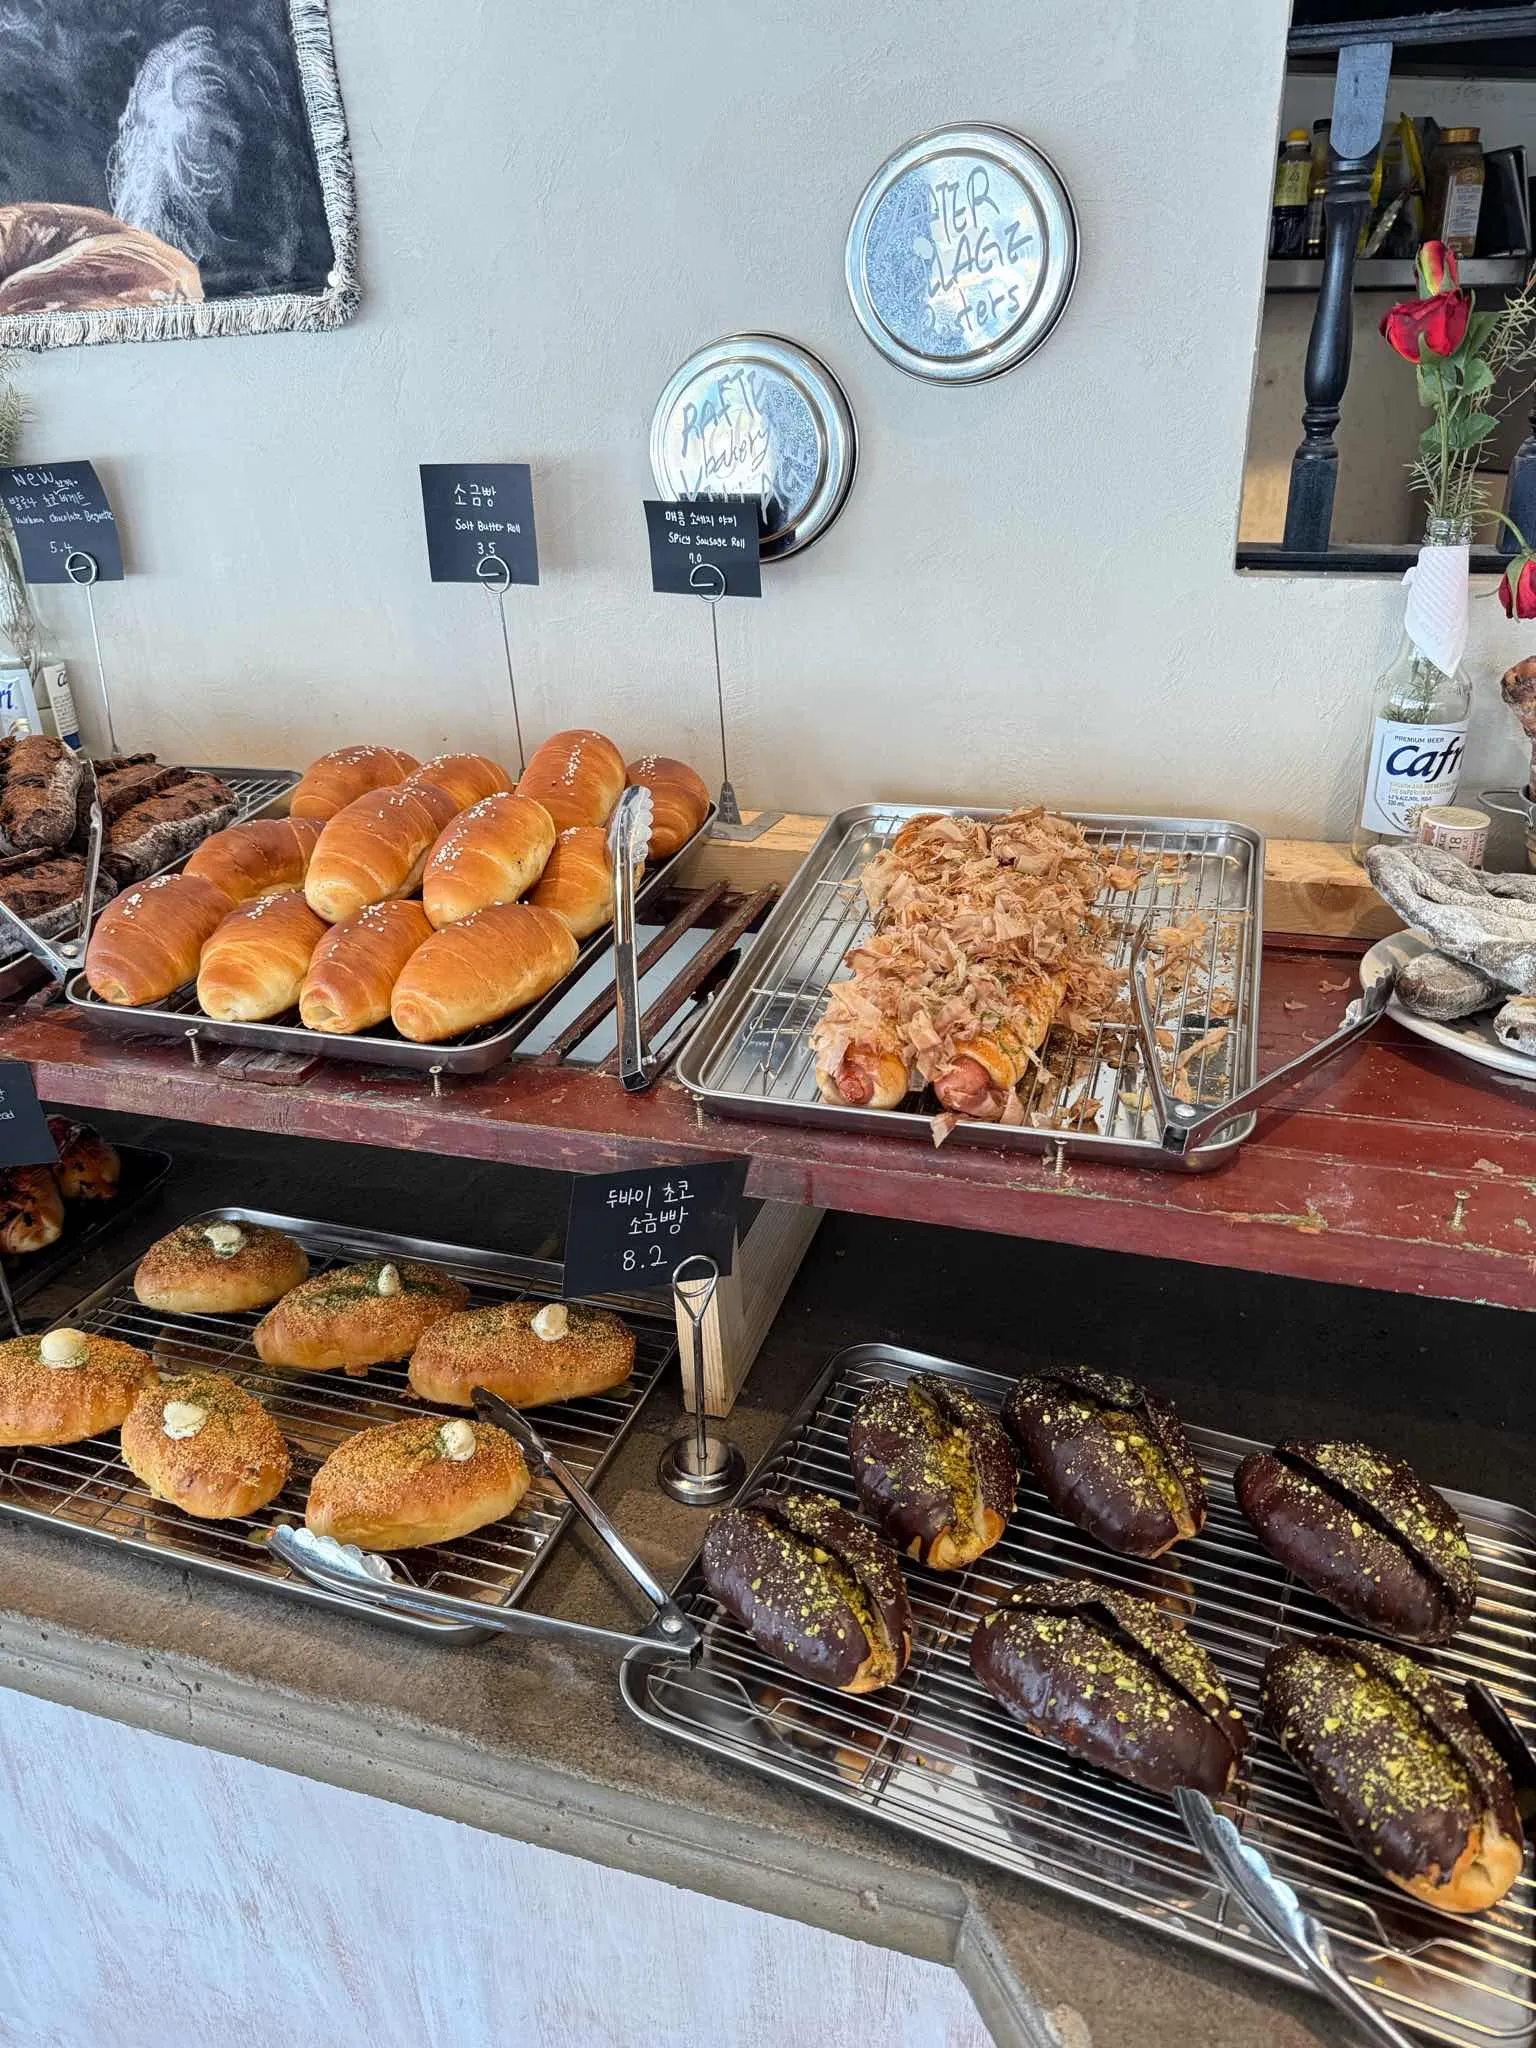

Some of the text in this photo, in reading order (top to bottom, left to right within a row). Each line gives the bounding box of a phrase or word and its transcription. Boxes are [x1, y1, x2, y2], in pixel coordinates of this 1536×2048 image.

[454, 483, 497, 507] 소금빵
[455, 518, 474, 531] Salt
[477, 520, 504, 532] Butter
[665, 511, 686, 526] 매콤
[49, 540, 73, 554] 5.4
[695, 535, 728, 547] Sausage
[731, 537, 745, 549] Roll
[606, 1180, 695, 1208] 두바이 초코
[628, 1206, 689, 1235] 소금빵
[622, 1245, 668, 1271] 8.2
